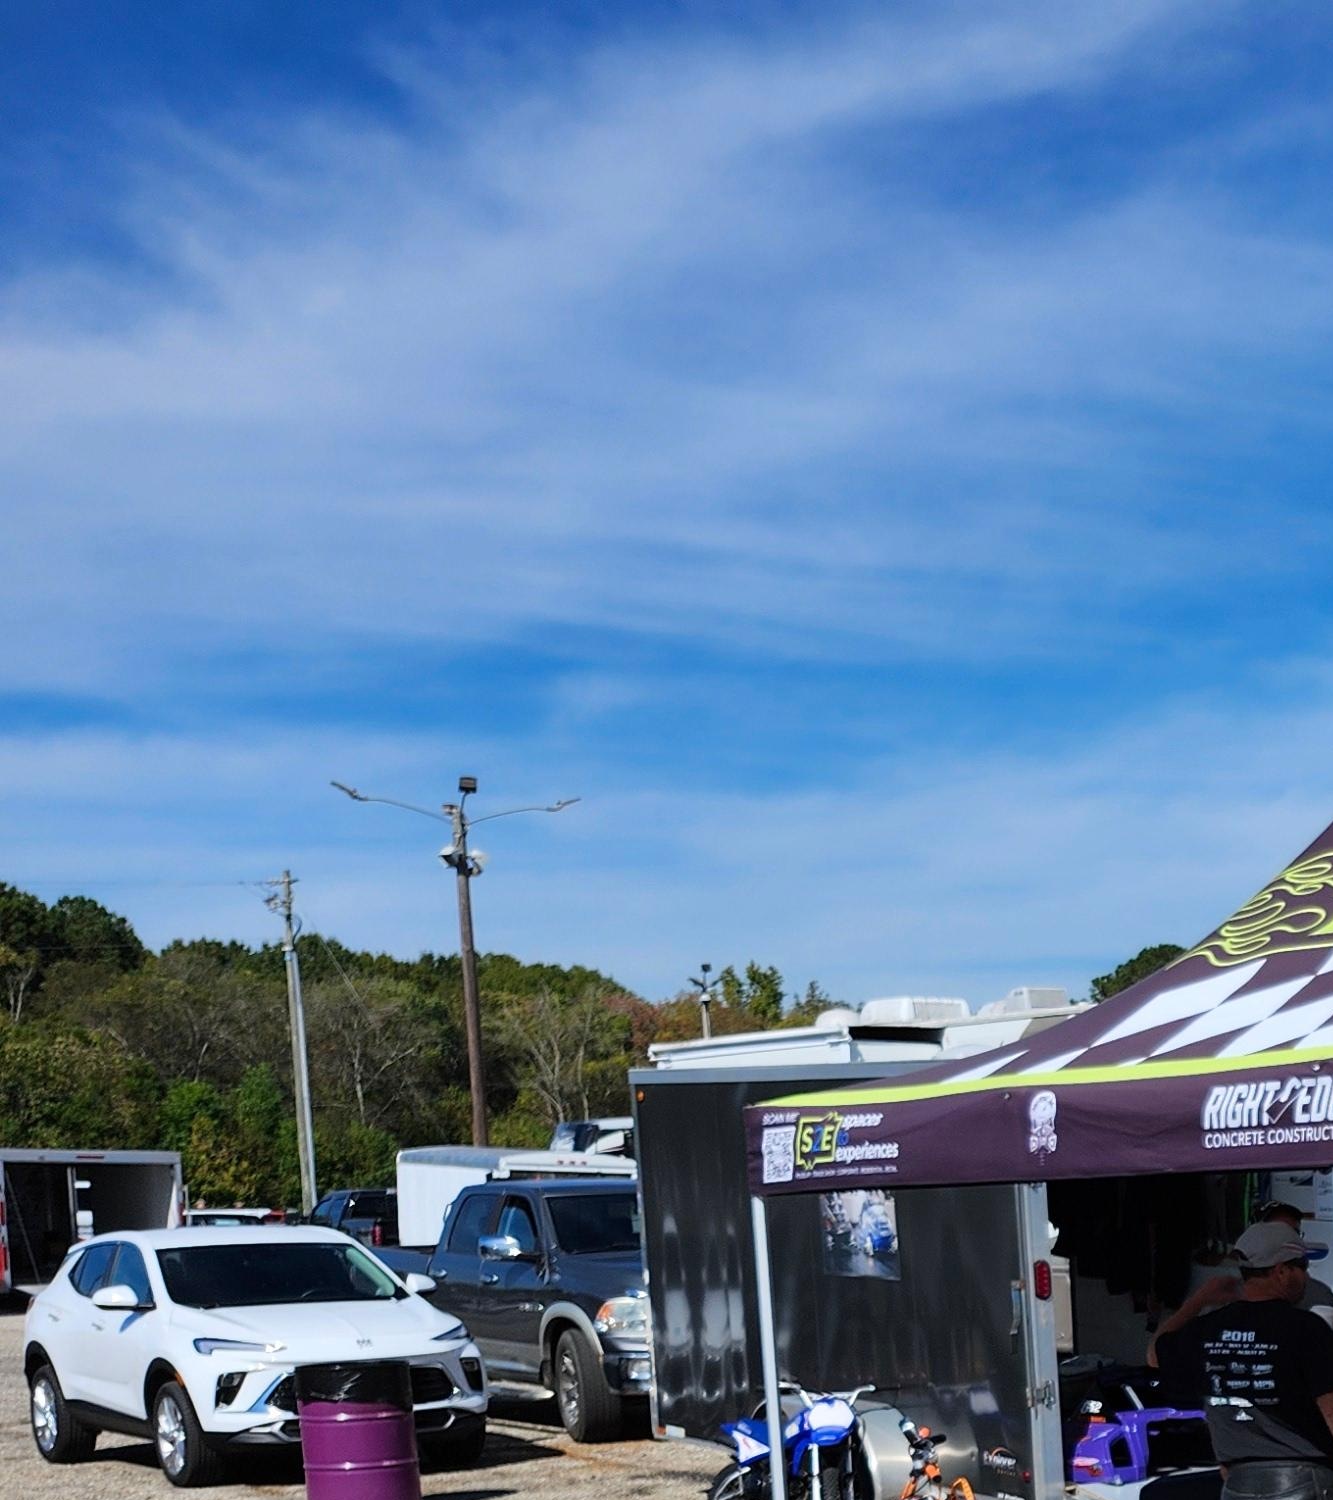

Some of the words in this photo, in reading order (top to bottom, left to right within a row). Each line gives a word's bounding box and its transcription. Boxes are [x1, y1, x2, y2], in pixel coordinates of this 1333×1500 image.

[1203, 1080, 1281, 1130] RIGHT
[841, 1113, 884, 1131] spaces
[801, 1125, 835, 1153] S2E
[1205, 1130, 1265, 1149] CONCRETE
[1222, 1330, 1255, 1342] 2018
